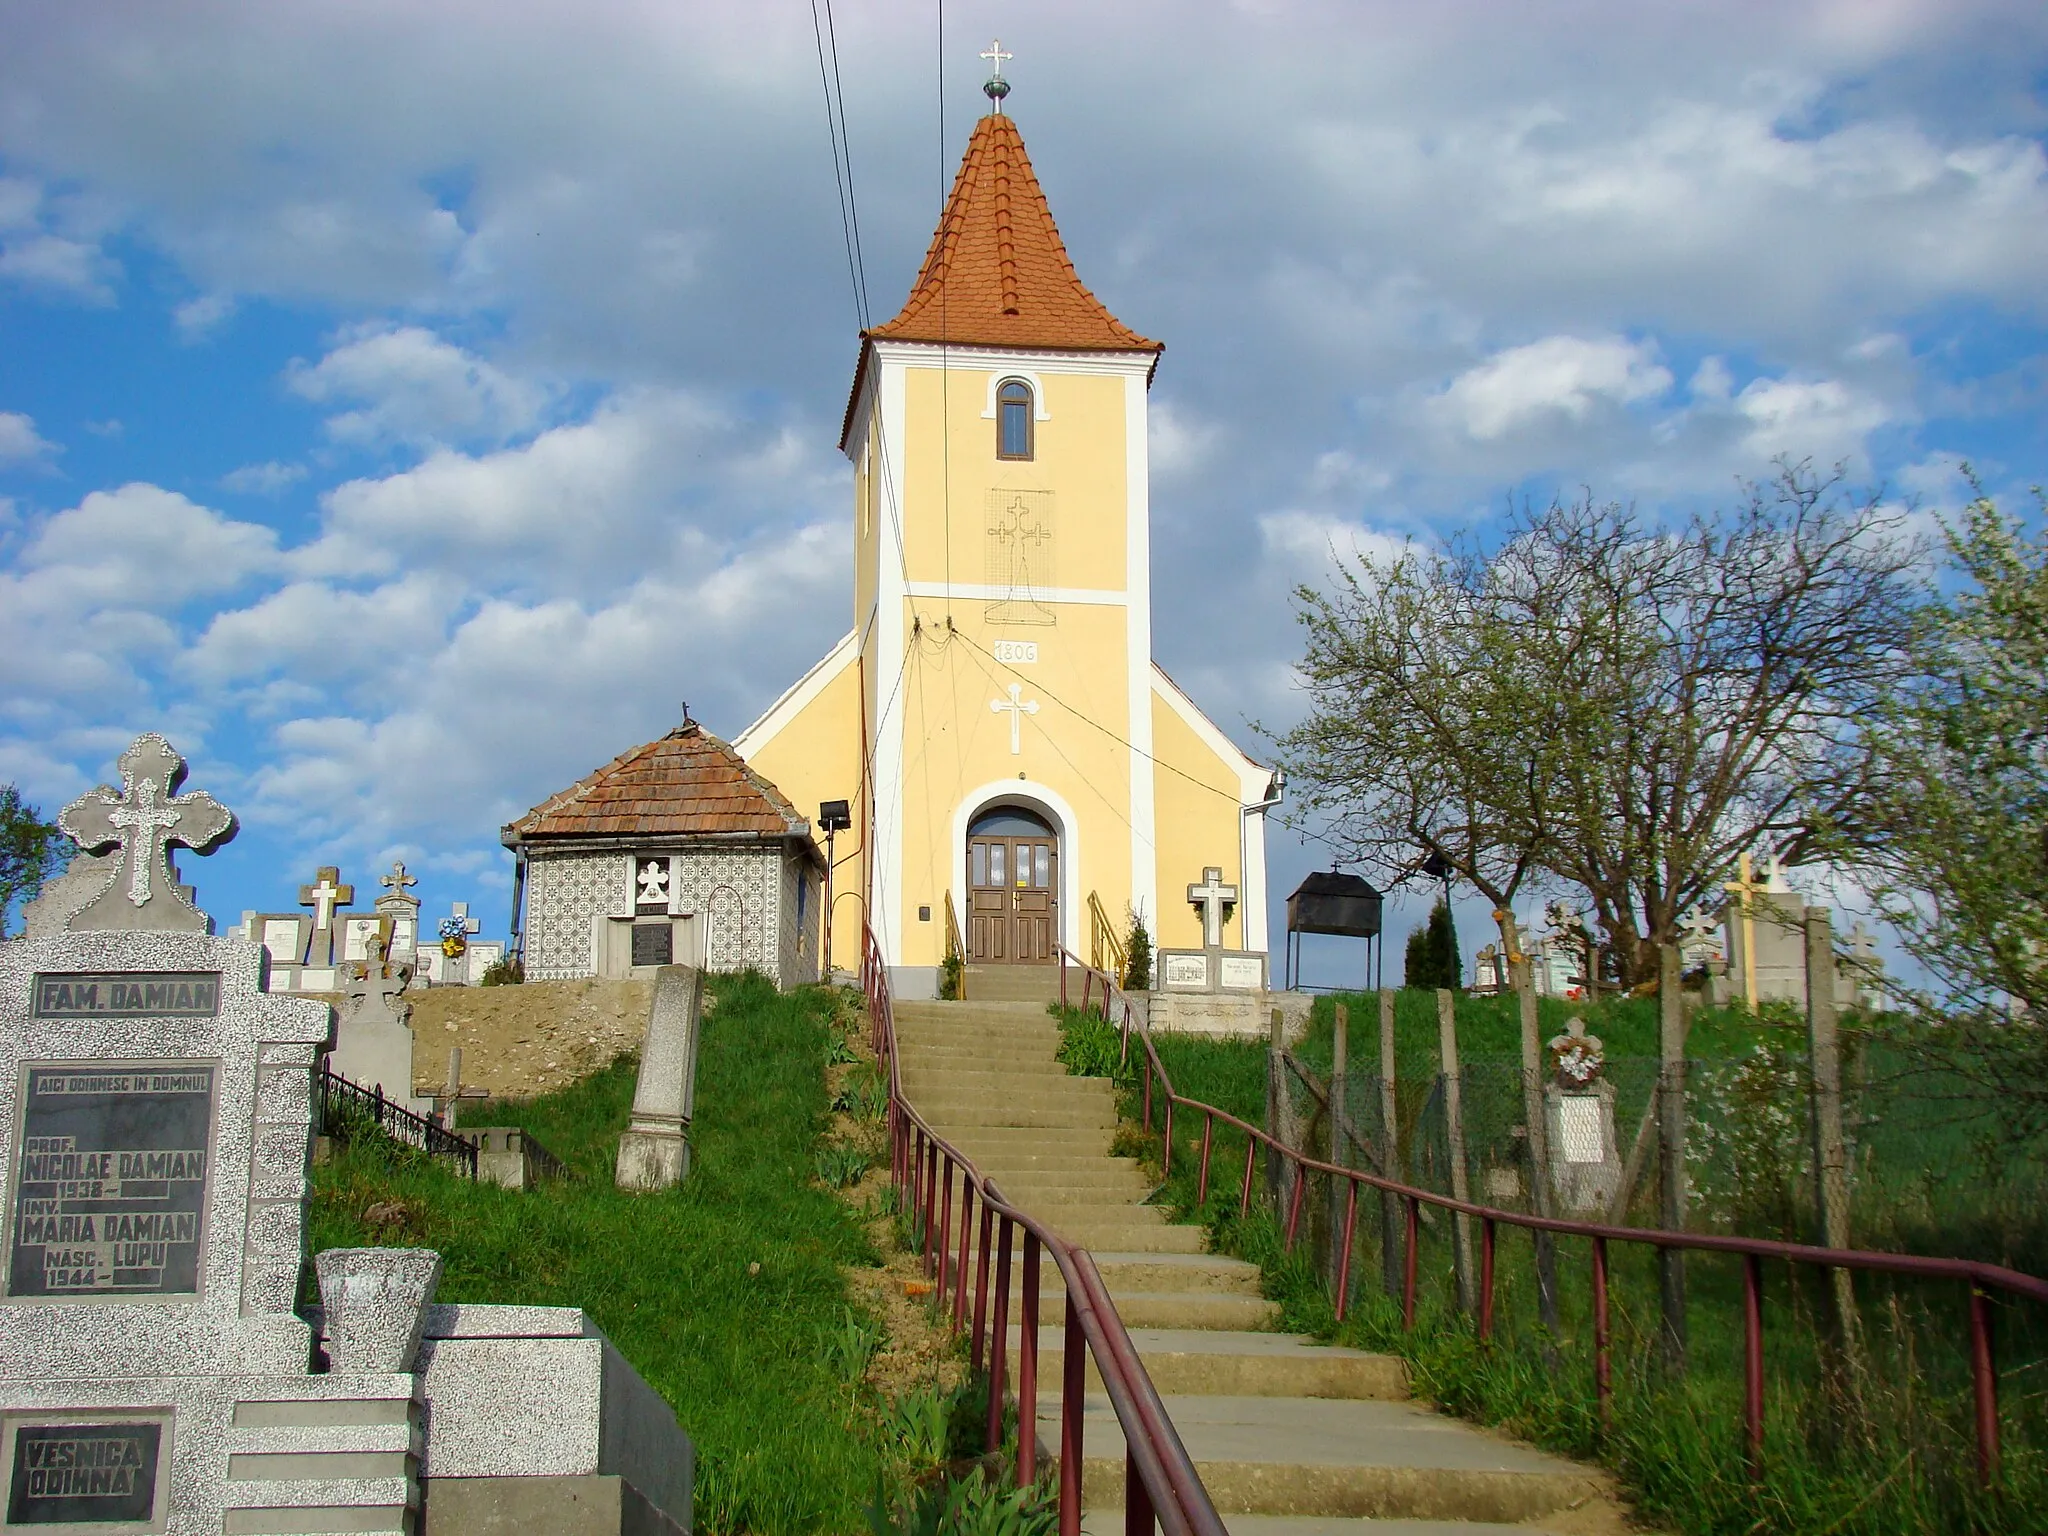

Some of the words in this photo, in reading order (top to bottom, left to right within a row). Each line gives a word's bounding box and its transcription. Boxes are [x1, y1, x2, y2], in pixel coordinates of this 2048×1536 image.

[43, 983, 104, 1010] FAM.
[110, 983, 216, 1010] DAMIAN
[39, 1078, 64, 1092] AICI
[153, 1075, 208, 1091] DOMNUL
[28, 1138, 74, 1152] PROF.
[25, 1154, 111, 1181] NICOLAE
[119, 1152, 203, 1180] DAMIAN
[23, 1215, 96, 1244] MARIA
[103, 1213, 194, 1243] DAMIAN
[113, 1243, 165, 1266] LUPU
[30, 1469, 132, 1495] ODIHNA
